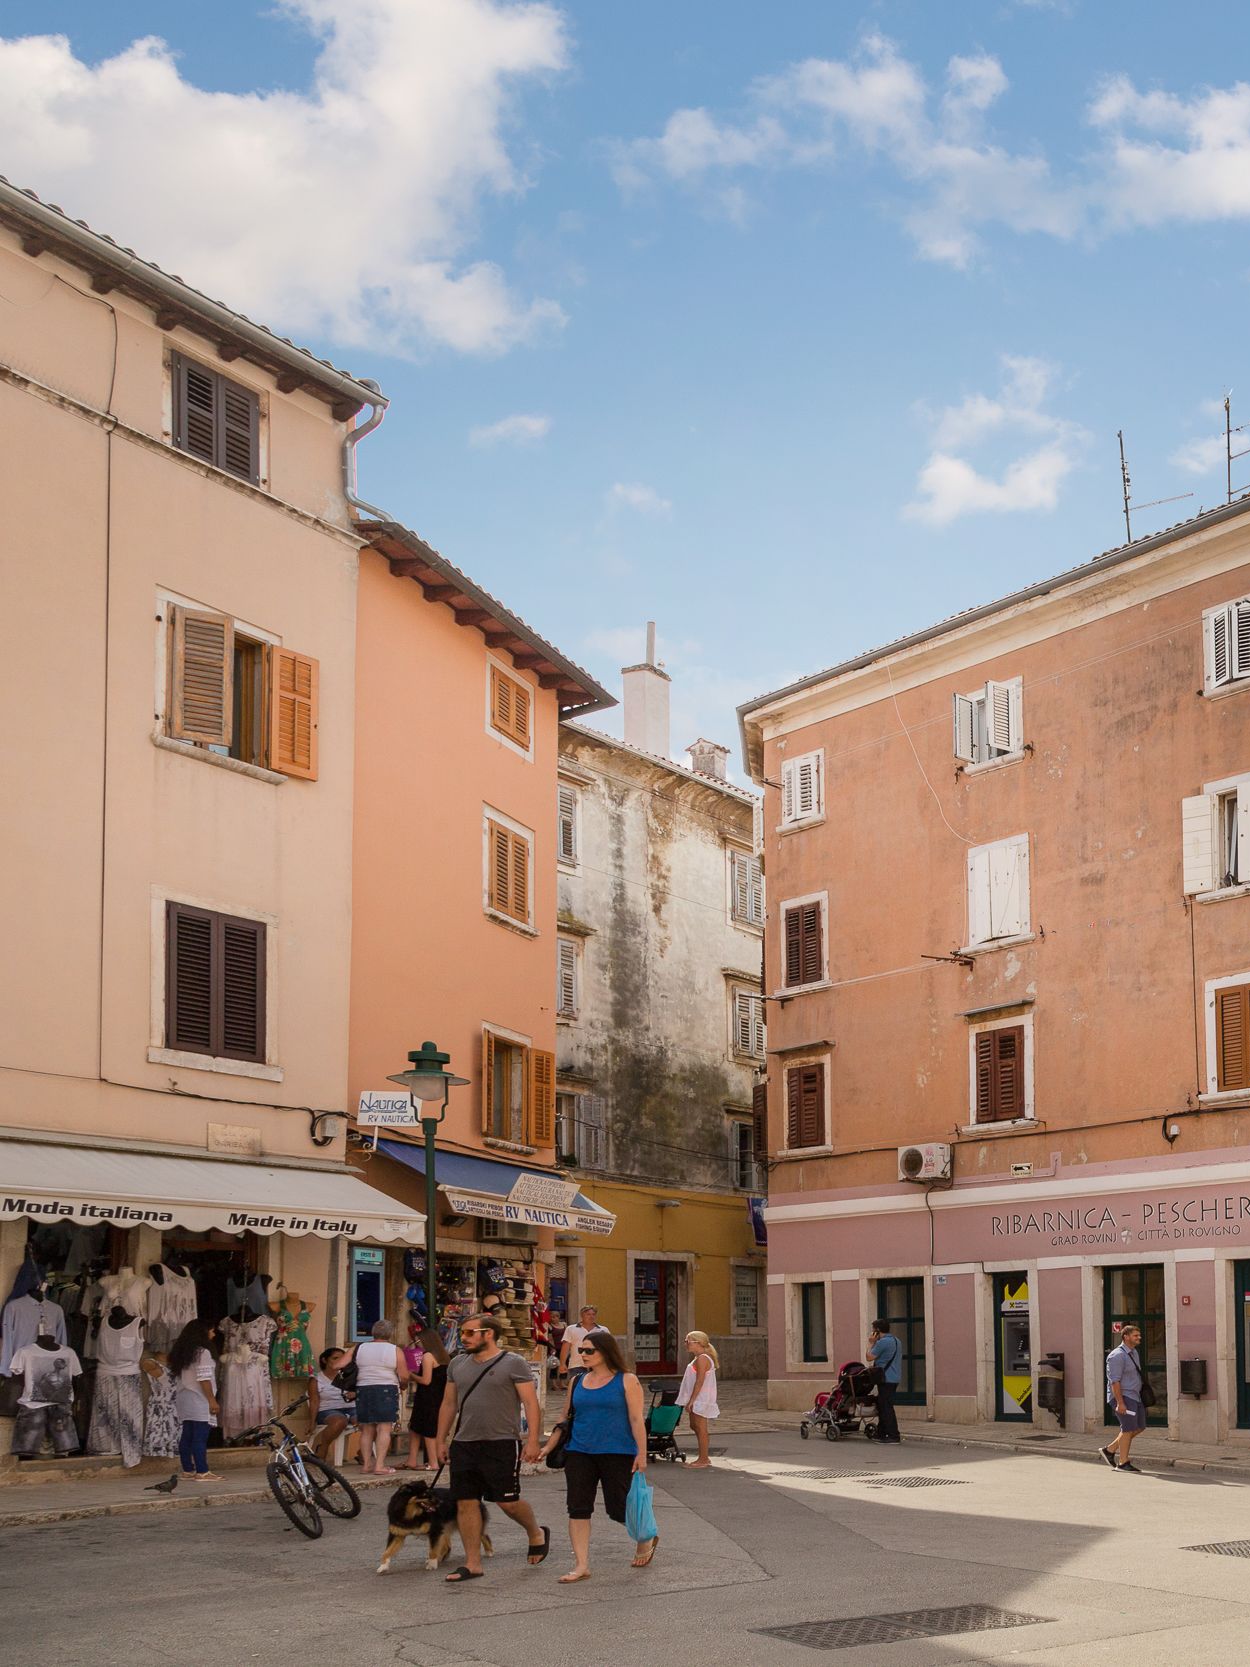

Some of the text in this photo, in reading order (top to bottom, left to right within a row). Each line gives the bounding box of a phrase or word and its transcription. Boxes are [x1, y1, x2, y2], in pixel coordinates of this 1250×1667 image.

[360, 1093, 408, 1110] NAUTICA
[367, 1114, 415, 1123] RV NAUTICA
[2, 1198, 173, 1223] Moda italiana
[505, 1205, 569, 1227] RV NAUTICA
[577, 1216, 595, 1225] ANGLER
[992, 1207, 1118, 1236] RIBARNICA
[228, 1213, 358, 1235] Made in Italy
[1051, 1224, 1241, 1246] GRAD ROVINJ CITTÀ DI ROVIGNO
